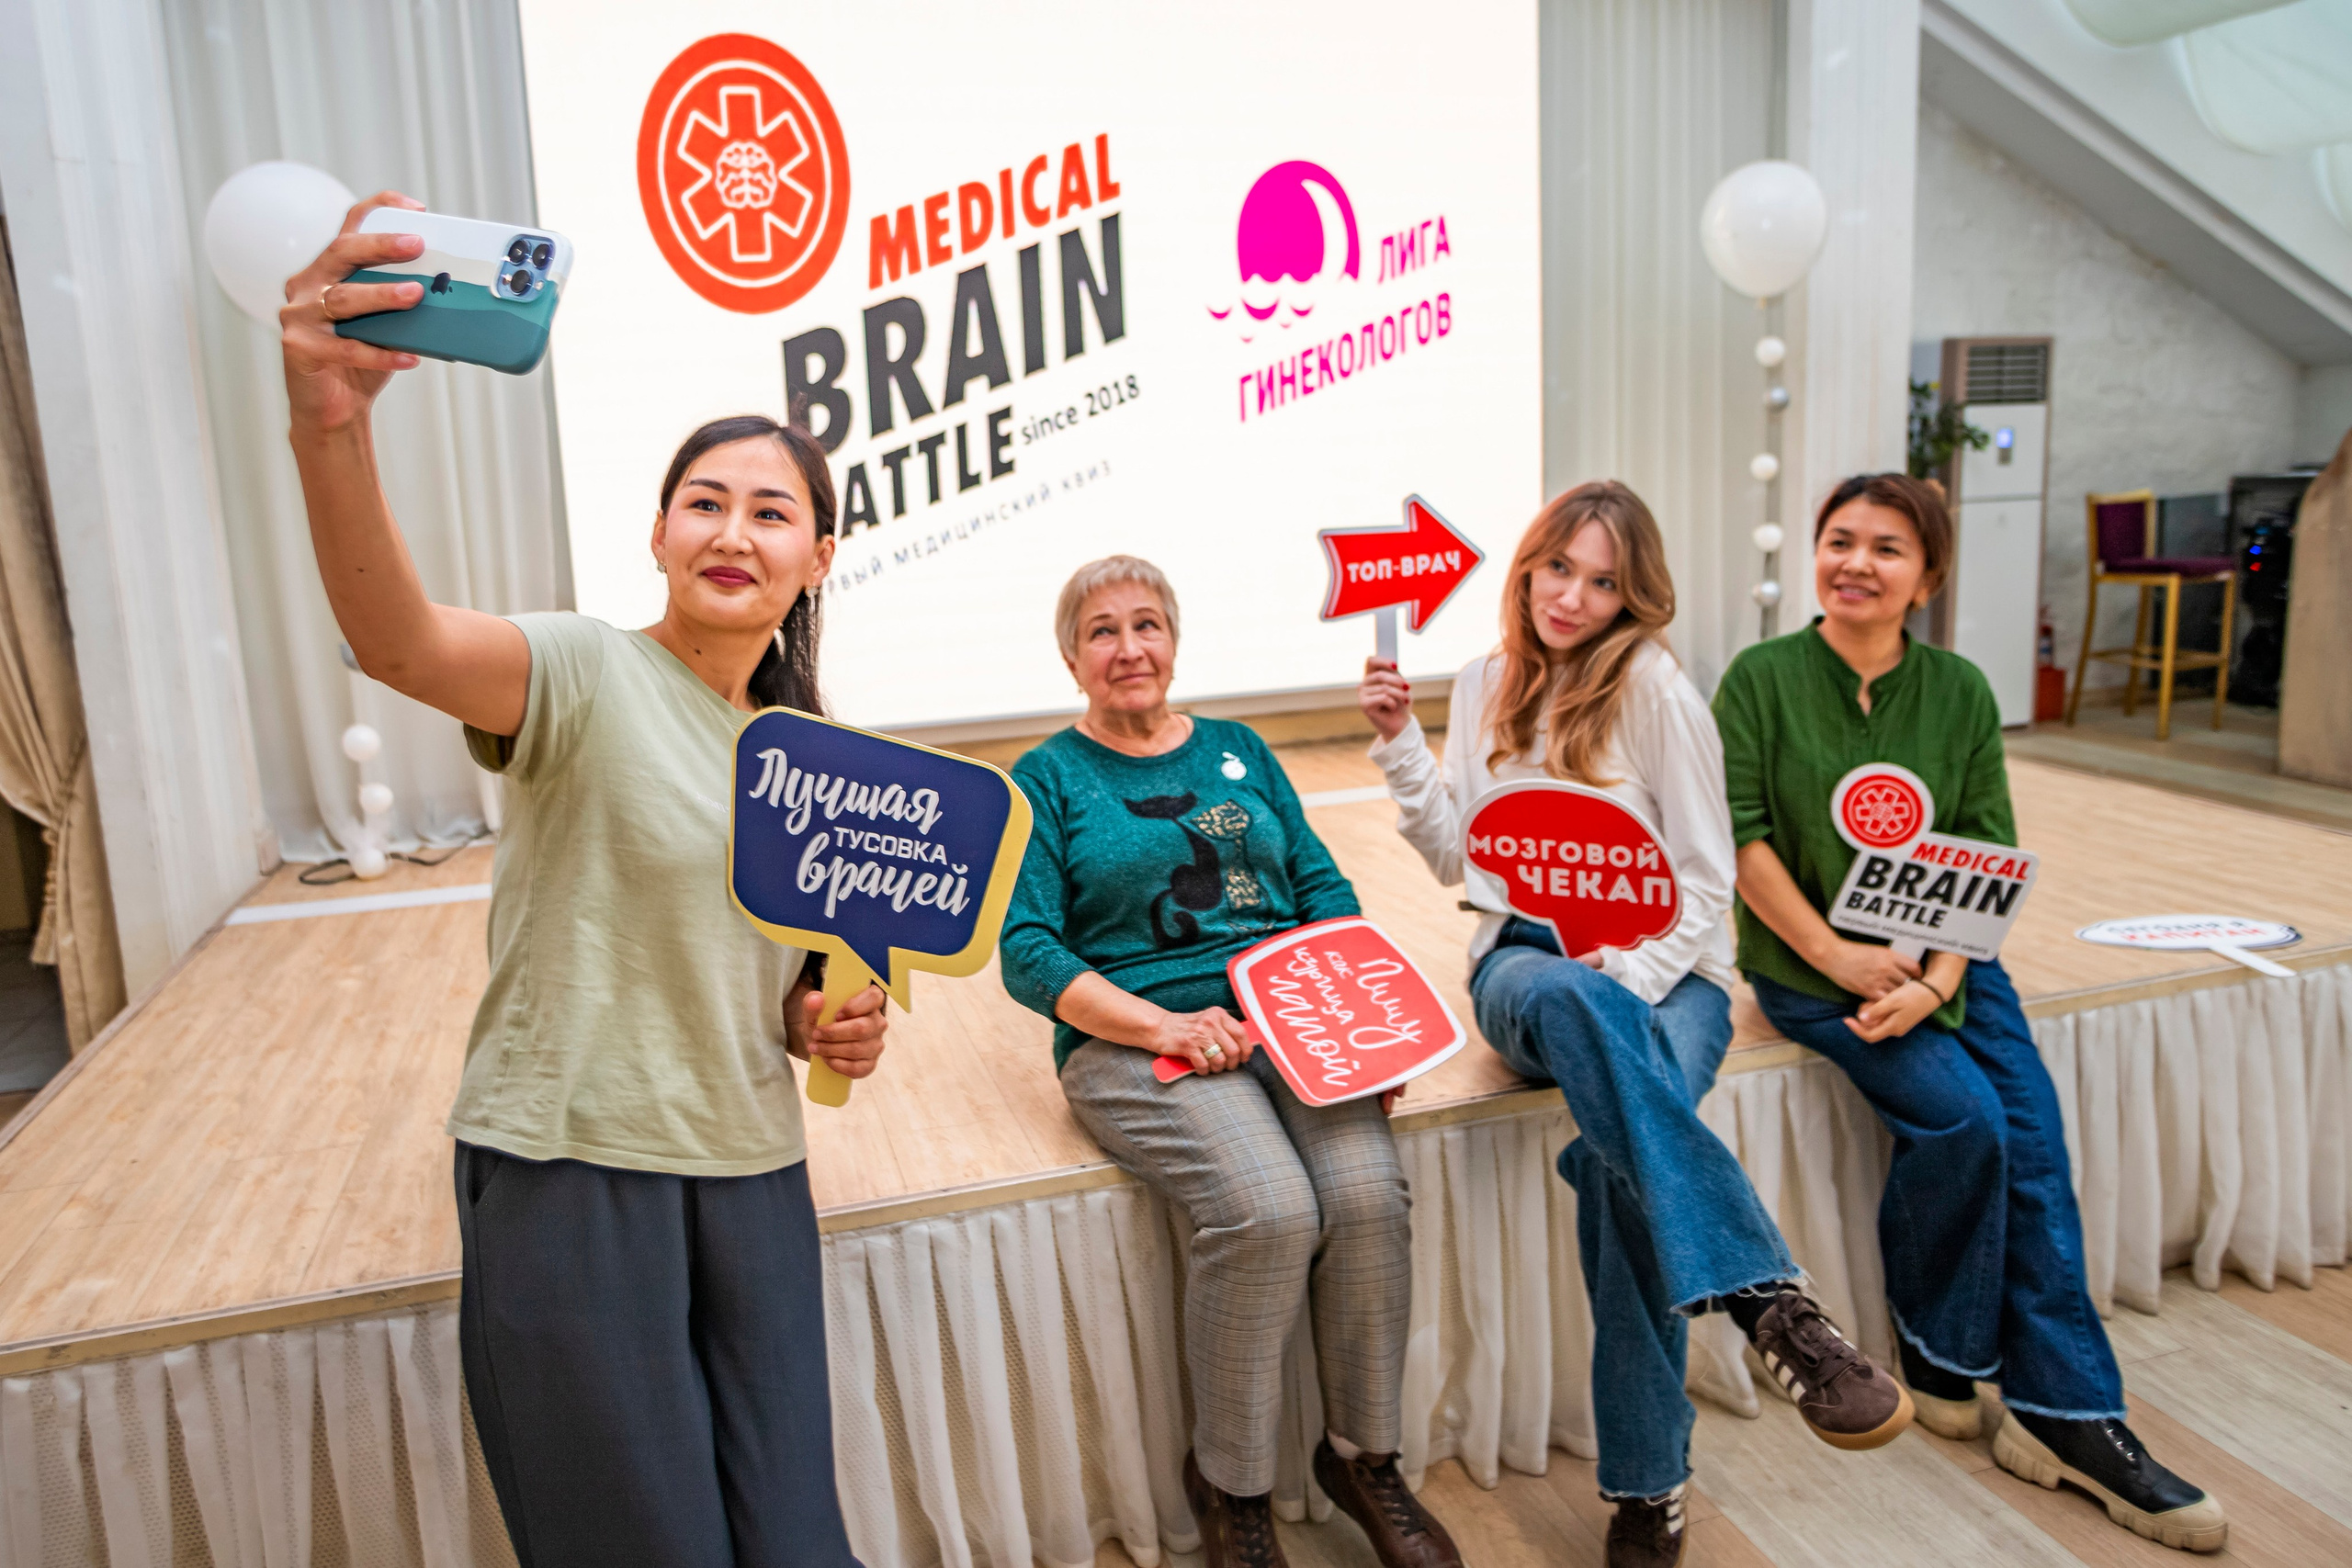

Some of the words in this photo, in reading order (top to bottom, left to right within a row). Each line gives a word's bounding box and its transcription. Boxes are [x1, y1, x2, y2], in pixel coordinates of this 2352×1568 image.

[868, 133, 1121, 291] MEDICAL
[1377, 215, 1452, 285] ЛИГА
[781, 211, 1126, 458] BRAIN
[1238, 291, 1453, 423] ГИНЕКОЛОГОВ
[839, 404, 1017, 541] ATTLE
[1021, 408, 1080, 446] since
[1083, 374, 1141, 419] 2018
[827, 555, 884, 593] РВЫЙ
[1346, 549, 1461, 584] ТОП-ВРАЧ
[748, 747, 944, 836] Лучшая
[796, 831, 971, 919] врачей
[832, 826, 948, 866] ТУСОВКА
[1468, 832, 1660, 871] МОЗГОВОЙ
[1911, 841, 2032, 882] MEDICAL
[1516, 863, 1671, 908] ЧЕКАП
[1844, 891, 1949, 930] BATTLE
[1855, 855, 2024, 919] BRAIN
[1285, 946, 1356, 1026] курица
[1323, 950, 1355, 981] как
[1347, 957, 1423, 1050] Пишу
